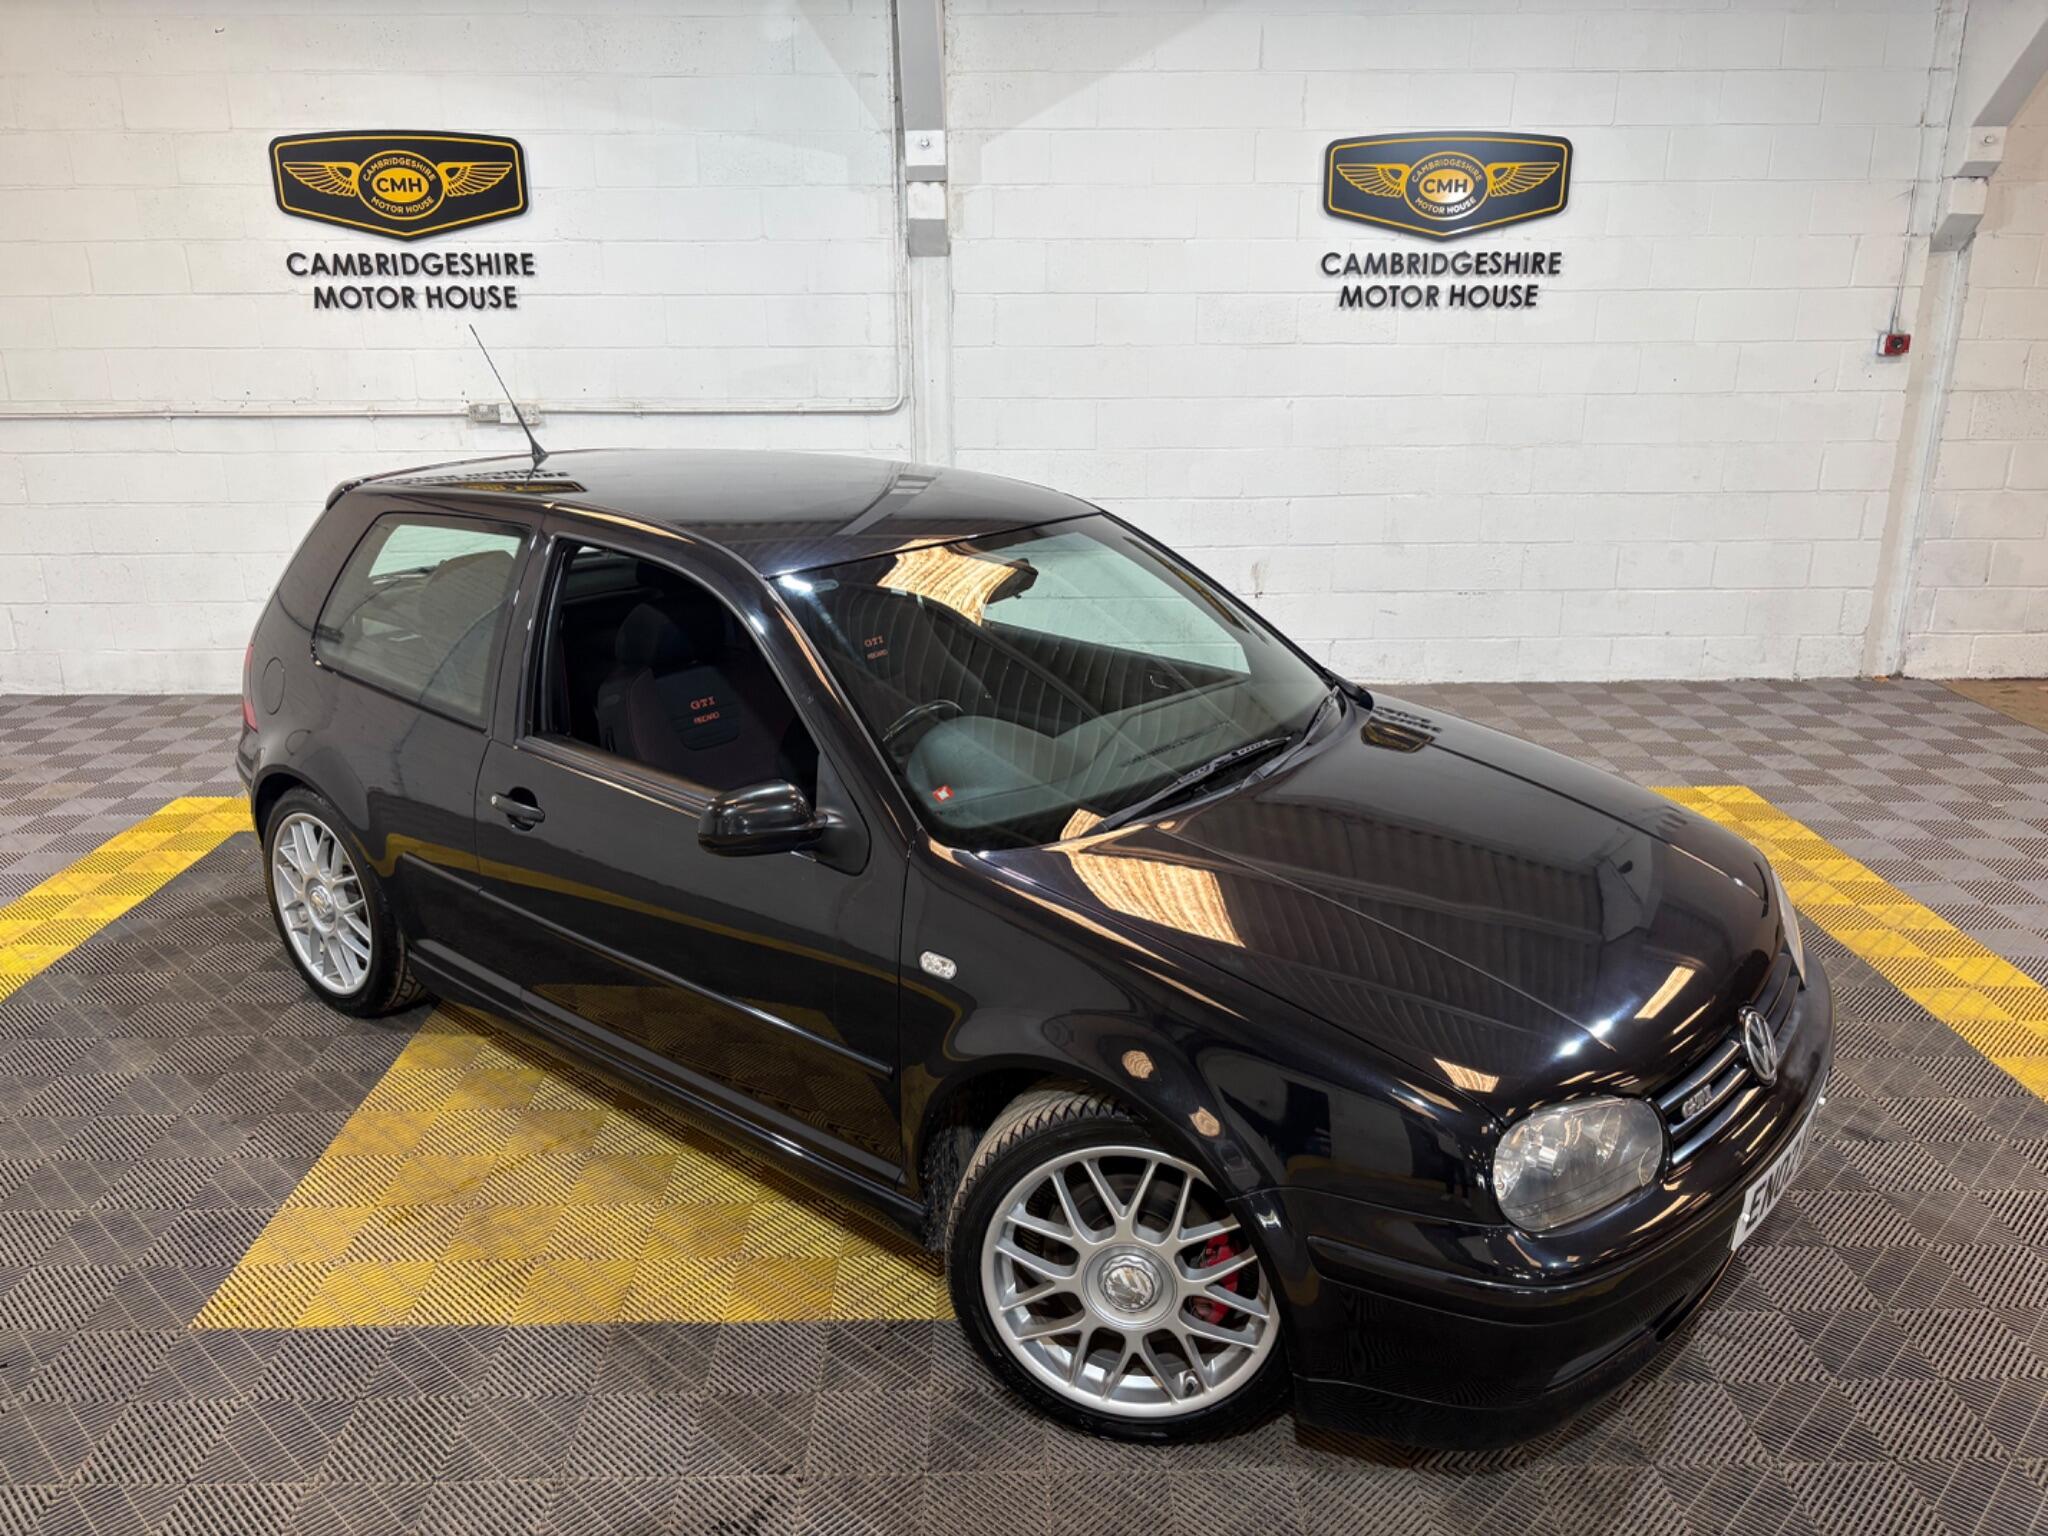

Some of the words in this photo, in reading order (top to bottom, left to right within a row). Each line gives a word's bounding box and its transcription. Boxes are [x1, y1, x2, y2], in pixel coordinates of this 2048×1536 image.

[362, 156, 437, 182] CAMBRIDGESHIRE
[1411, 157, 1483, 183] CAMBRIDGESHIRE
[376, 177, 423, 193] CMH
[1422, 177, 1468, 194] CMH
[370, 196, 404, 214] MOTOR
[405, 196, 435, 214] HOUSE
[1414, 196, 1445, 214] MOTOR
[1446, 196, 1477, 214] HOUSE
[286, 252, 536, 277] CAMBRIDGESHIRE
[1321, 251, 1562, 276] CAMBRIDGESHIRE
[314, 286, 416, 310] MOTOR
[427, 285, 518, 310] HOUSE
[1339, 285, 1439, 308] MOTOR
[1449, 284, 1539, 308] HOUSE
[864, 635, 884, 648] GTI
[690, 695, 715, 710] GTI
